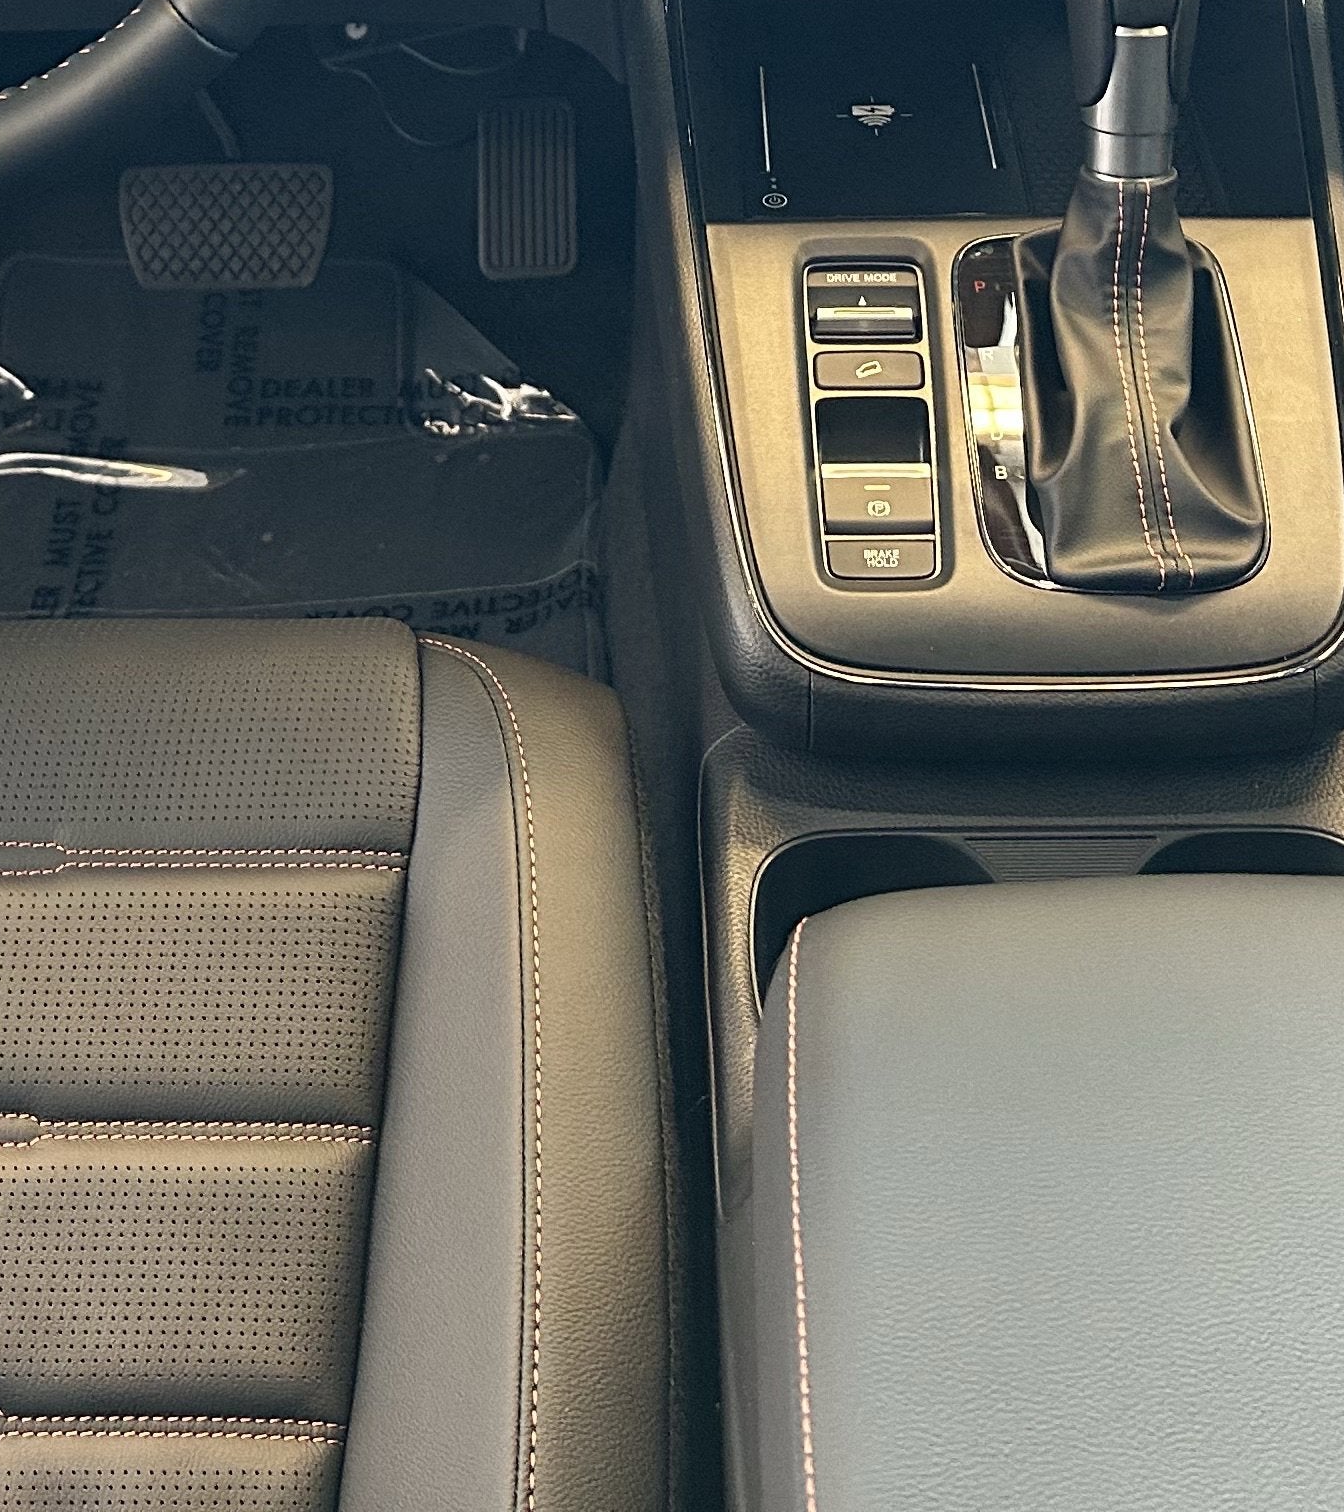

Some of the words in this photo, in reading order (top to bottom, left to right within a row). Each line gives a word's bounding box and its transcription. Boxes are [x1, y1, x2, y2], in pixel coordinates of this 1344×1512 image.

[826, 273, 860, 283] DRIVE
[863, 273, 897, 283] MODE
[974, 280, 986, 293] P
[981, 350, 994, 361] R
[259, 377, 374, 399] DEALER
[863, 549, 900, 559] BRAKE
[867, 558, 899, 568] HOLD
